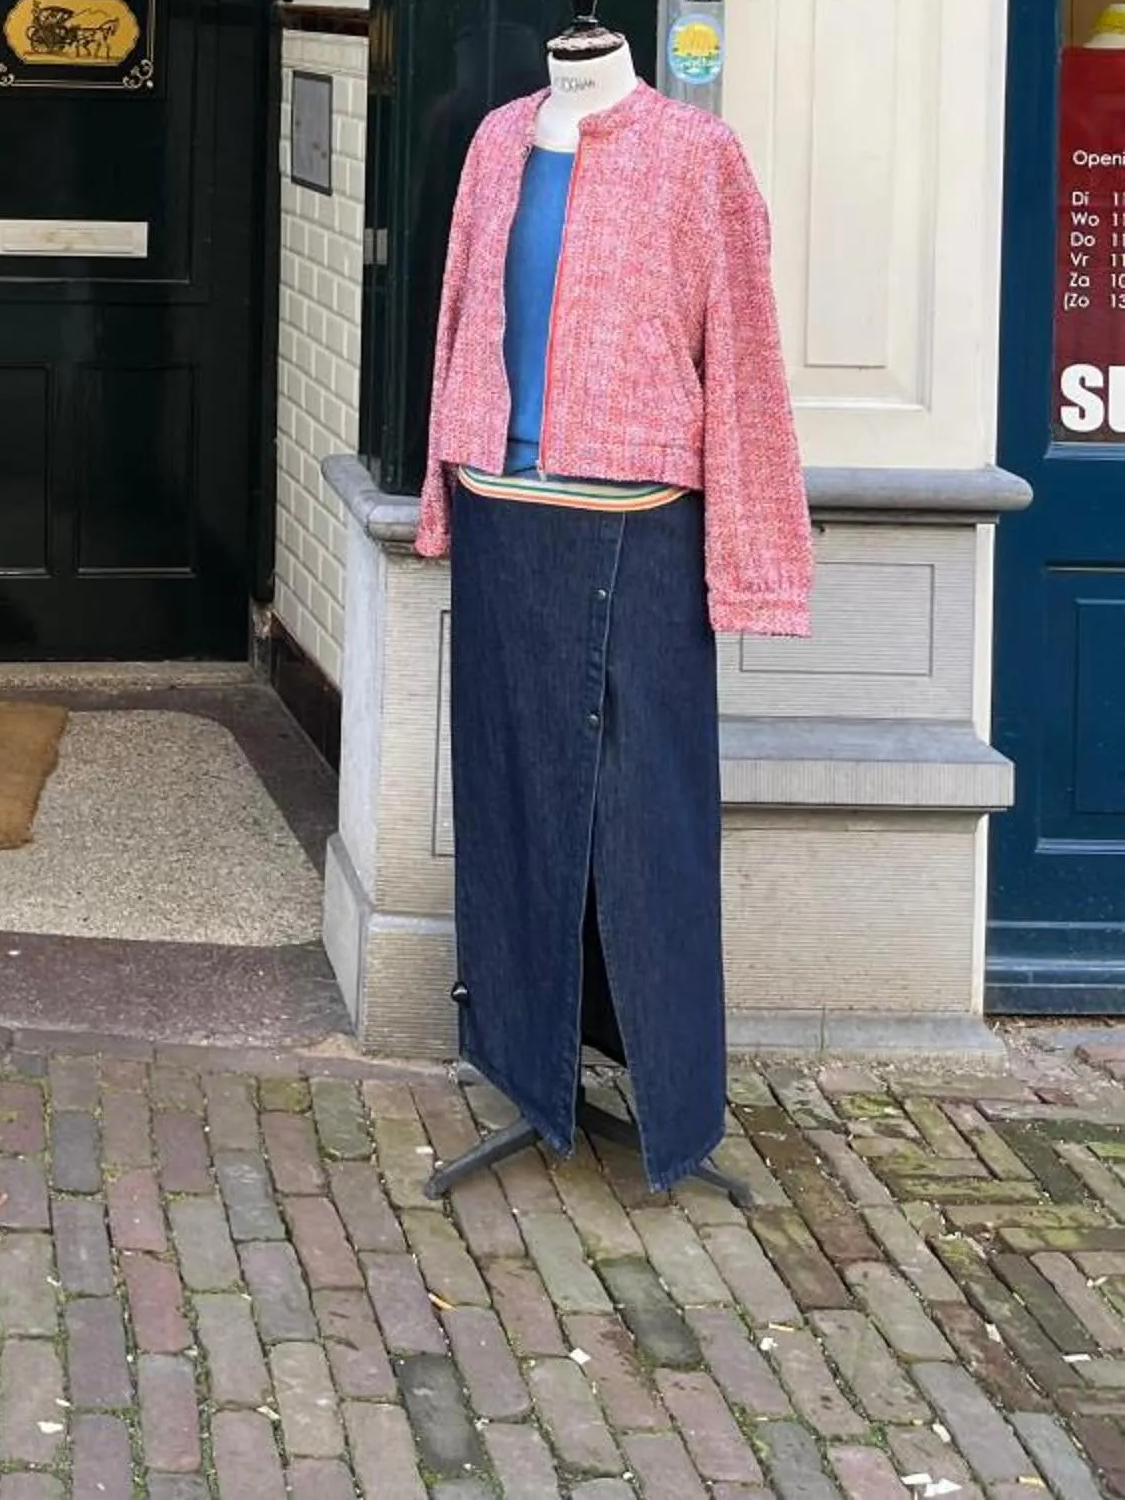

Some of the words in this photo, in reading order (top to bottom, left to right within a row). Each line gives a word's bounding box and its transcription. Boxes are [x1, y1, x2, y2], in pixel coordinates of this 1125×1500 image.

[1072, 190, 1090, 206] Di
[1070, 211, 1100, 227] Wo
[1070, 231, 1096, 247] Do
[1070, 251, 1090, 267] Vr
[1069, 272, 1091, 288] Za
[1063, 291, 1091, 311] (Zo
